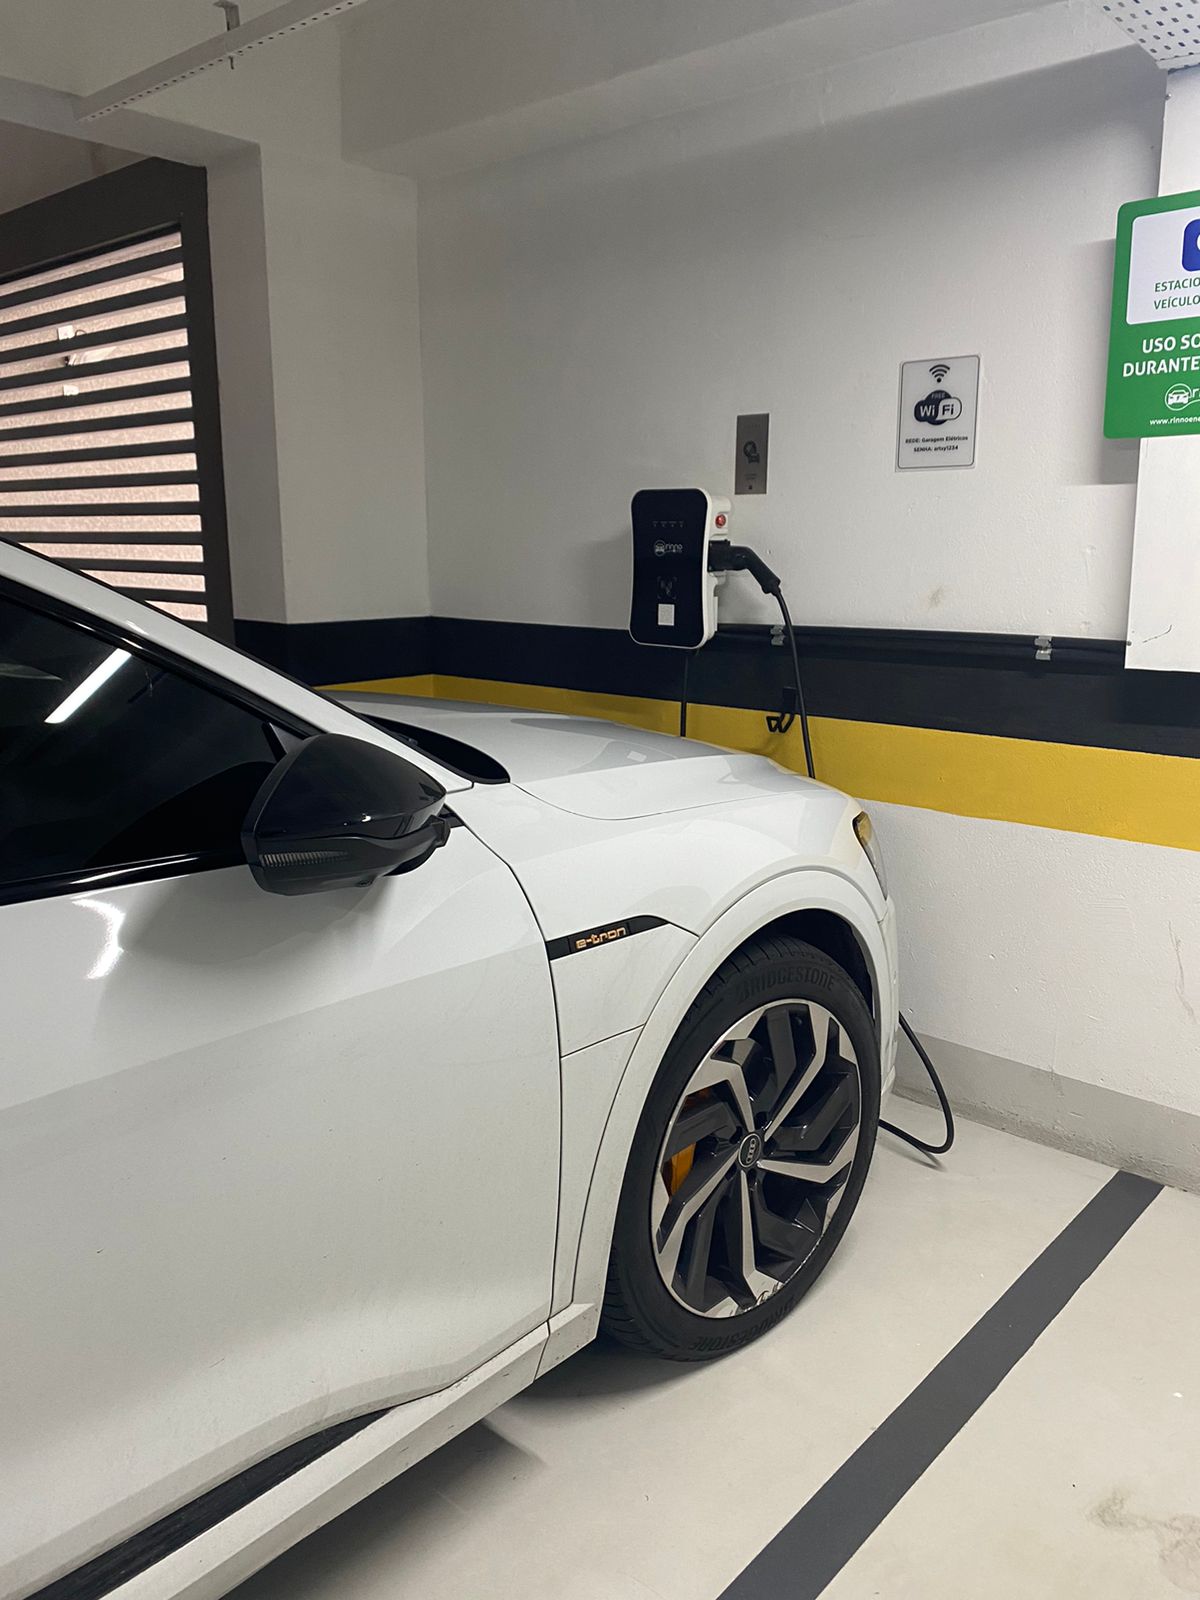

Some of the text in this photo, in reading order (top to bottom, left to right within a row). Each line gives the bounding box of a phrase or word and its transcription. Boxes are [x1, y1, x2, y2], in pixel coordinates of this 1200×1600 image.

[1142, 336, 1176, 353] USO
[1123, 356, 1200, 377] DURANTE
[575, 927, 627, 949] e-tron
[736, 967, 834, 1003] BRIDGESTONE
